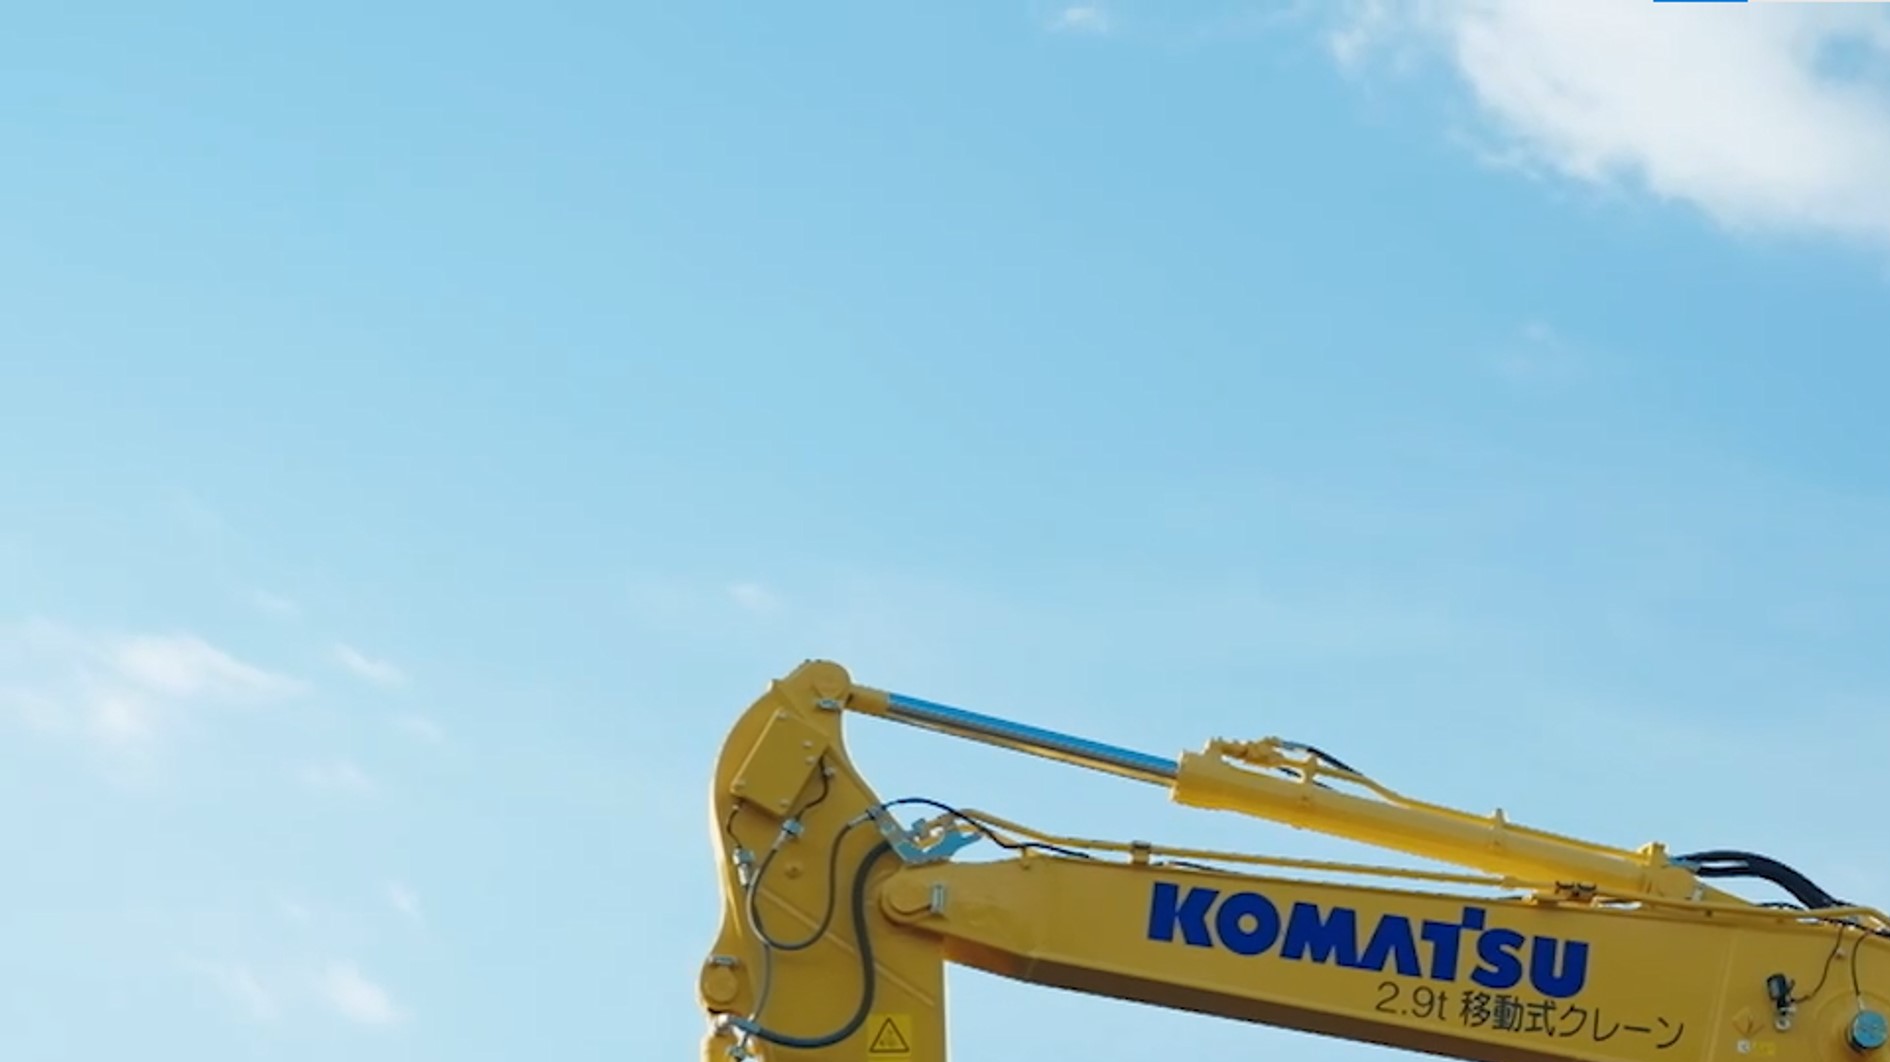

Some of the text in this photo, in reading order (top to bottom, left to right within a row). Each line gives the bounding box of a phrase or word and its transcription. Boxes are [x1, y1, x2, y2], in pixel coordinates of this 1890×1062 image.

[1147, 881, 1590, 998] KOMATSU
[1375, 981, 1685, 1049] 2.9t 移動式クレーン
